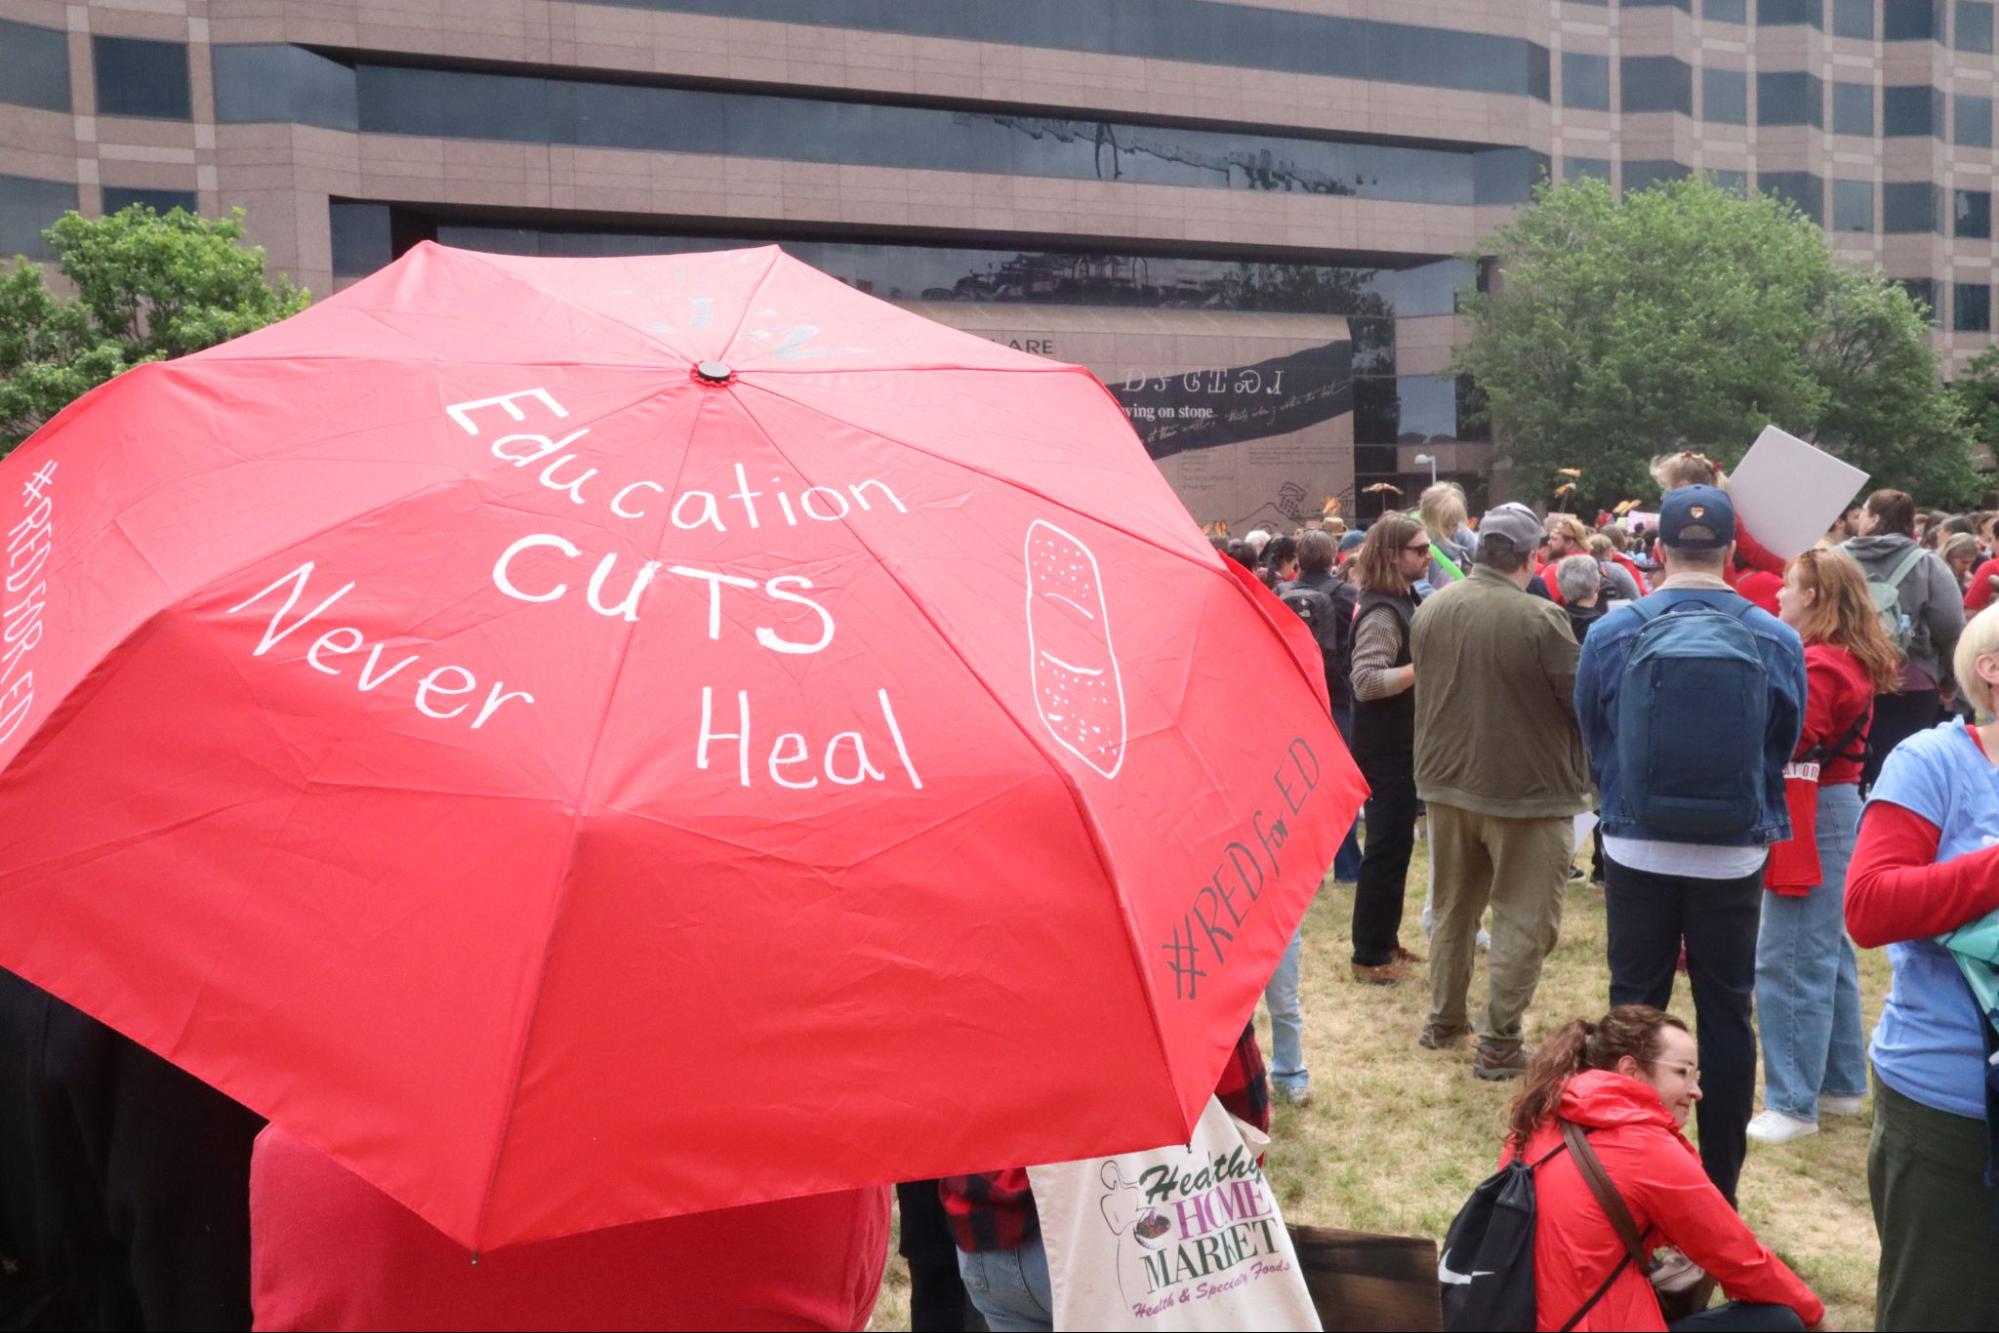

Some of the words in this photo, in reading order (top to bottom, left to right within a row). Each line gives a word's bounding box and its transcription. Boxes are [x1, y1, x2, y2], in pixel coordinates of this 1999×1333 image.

[1007, 339, 1053, 354] ARE
[1125, 404, 1155, 421] ving
[1158, 407, 1175, 418] on
[1178, 405, 1214, 418] stone
[446, 387, 908, 531] Education
[492, 533, 835, 654] CUTS
[227, 560, 534, 729] Never
[696, 685, 924, 790] Heal
[1274, 737, 1320, 815] ED
[1171, 1179, 1272, 1241] HOME
[1132, 1293, 1175, 1318] Health
[1178, 1287, 1191, 1304] &
[1250, 1259, 1291, 1281] Foods
[1139, 1217, 1280, 1294] MARKET
